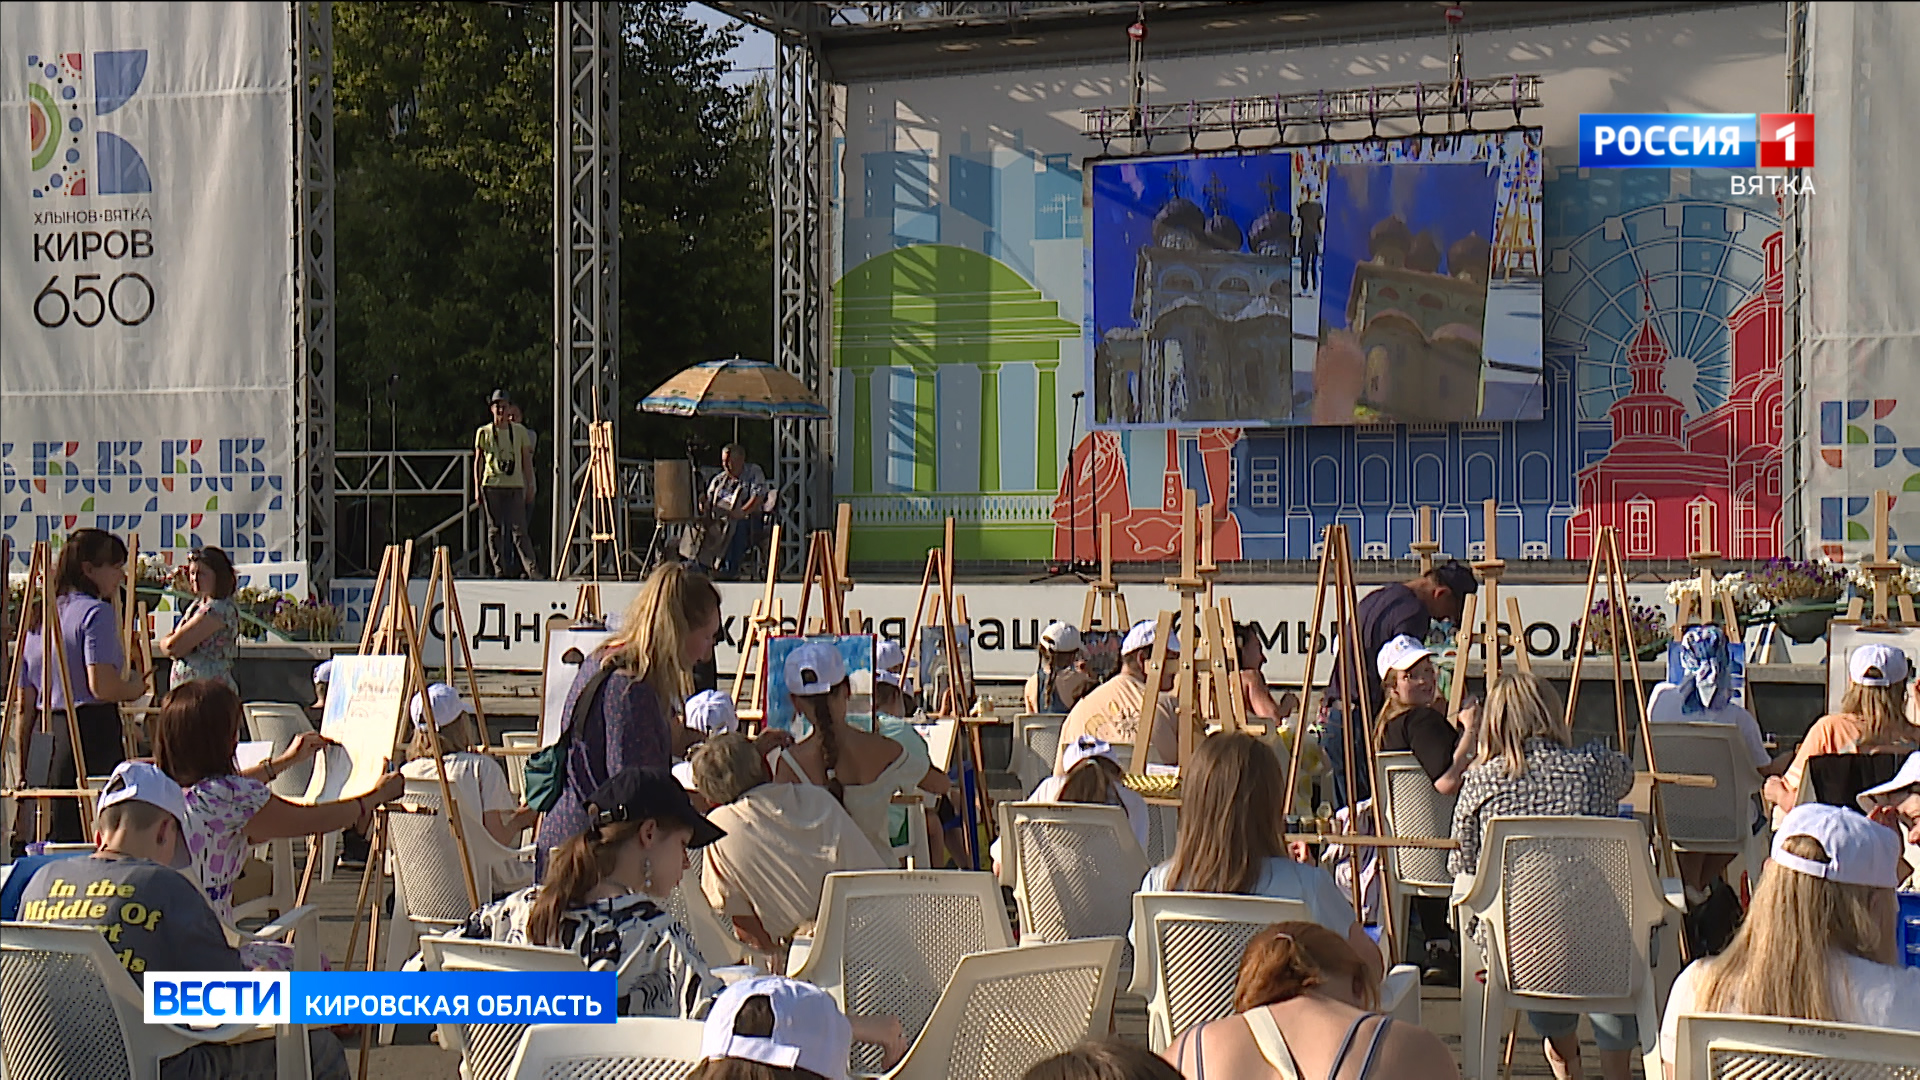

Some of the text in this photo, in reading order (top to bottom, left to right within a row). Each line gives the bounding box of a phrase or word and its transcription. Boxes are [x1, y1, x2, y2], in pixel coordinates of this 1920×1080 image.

[34, 230, 154, 262] КИРОВ
[33, 272, 155, 328] 650
[48, 879, 135, 898] In the
[120, 902, 162, 932] Of
